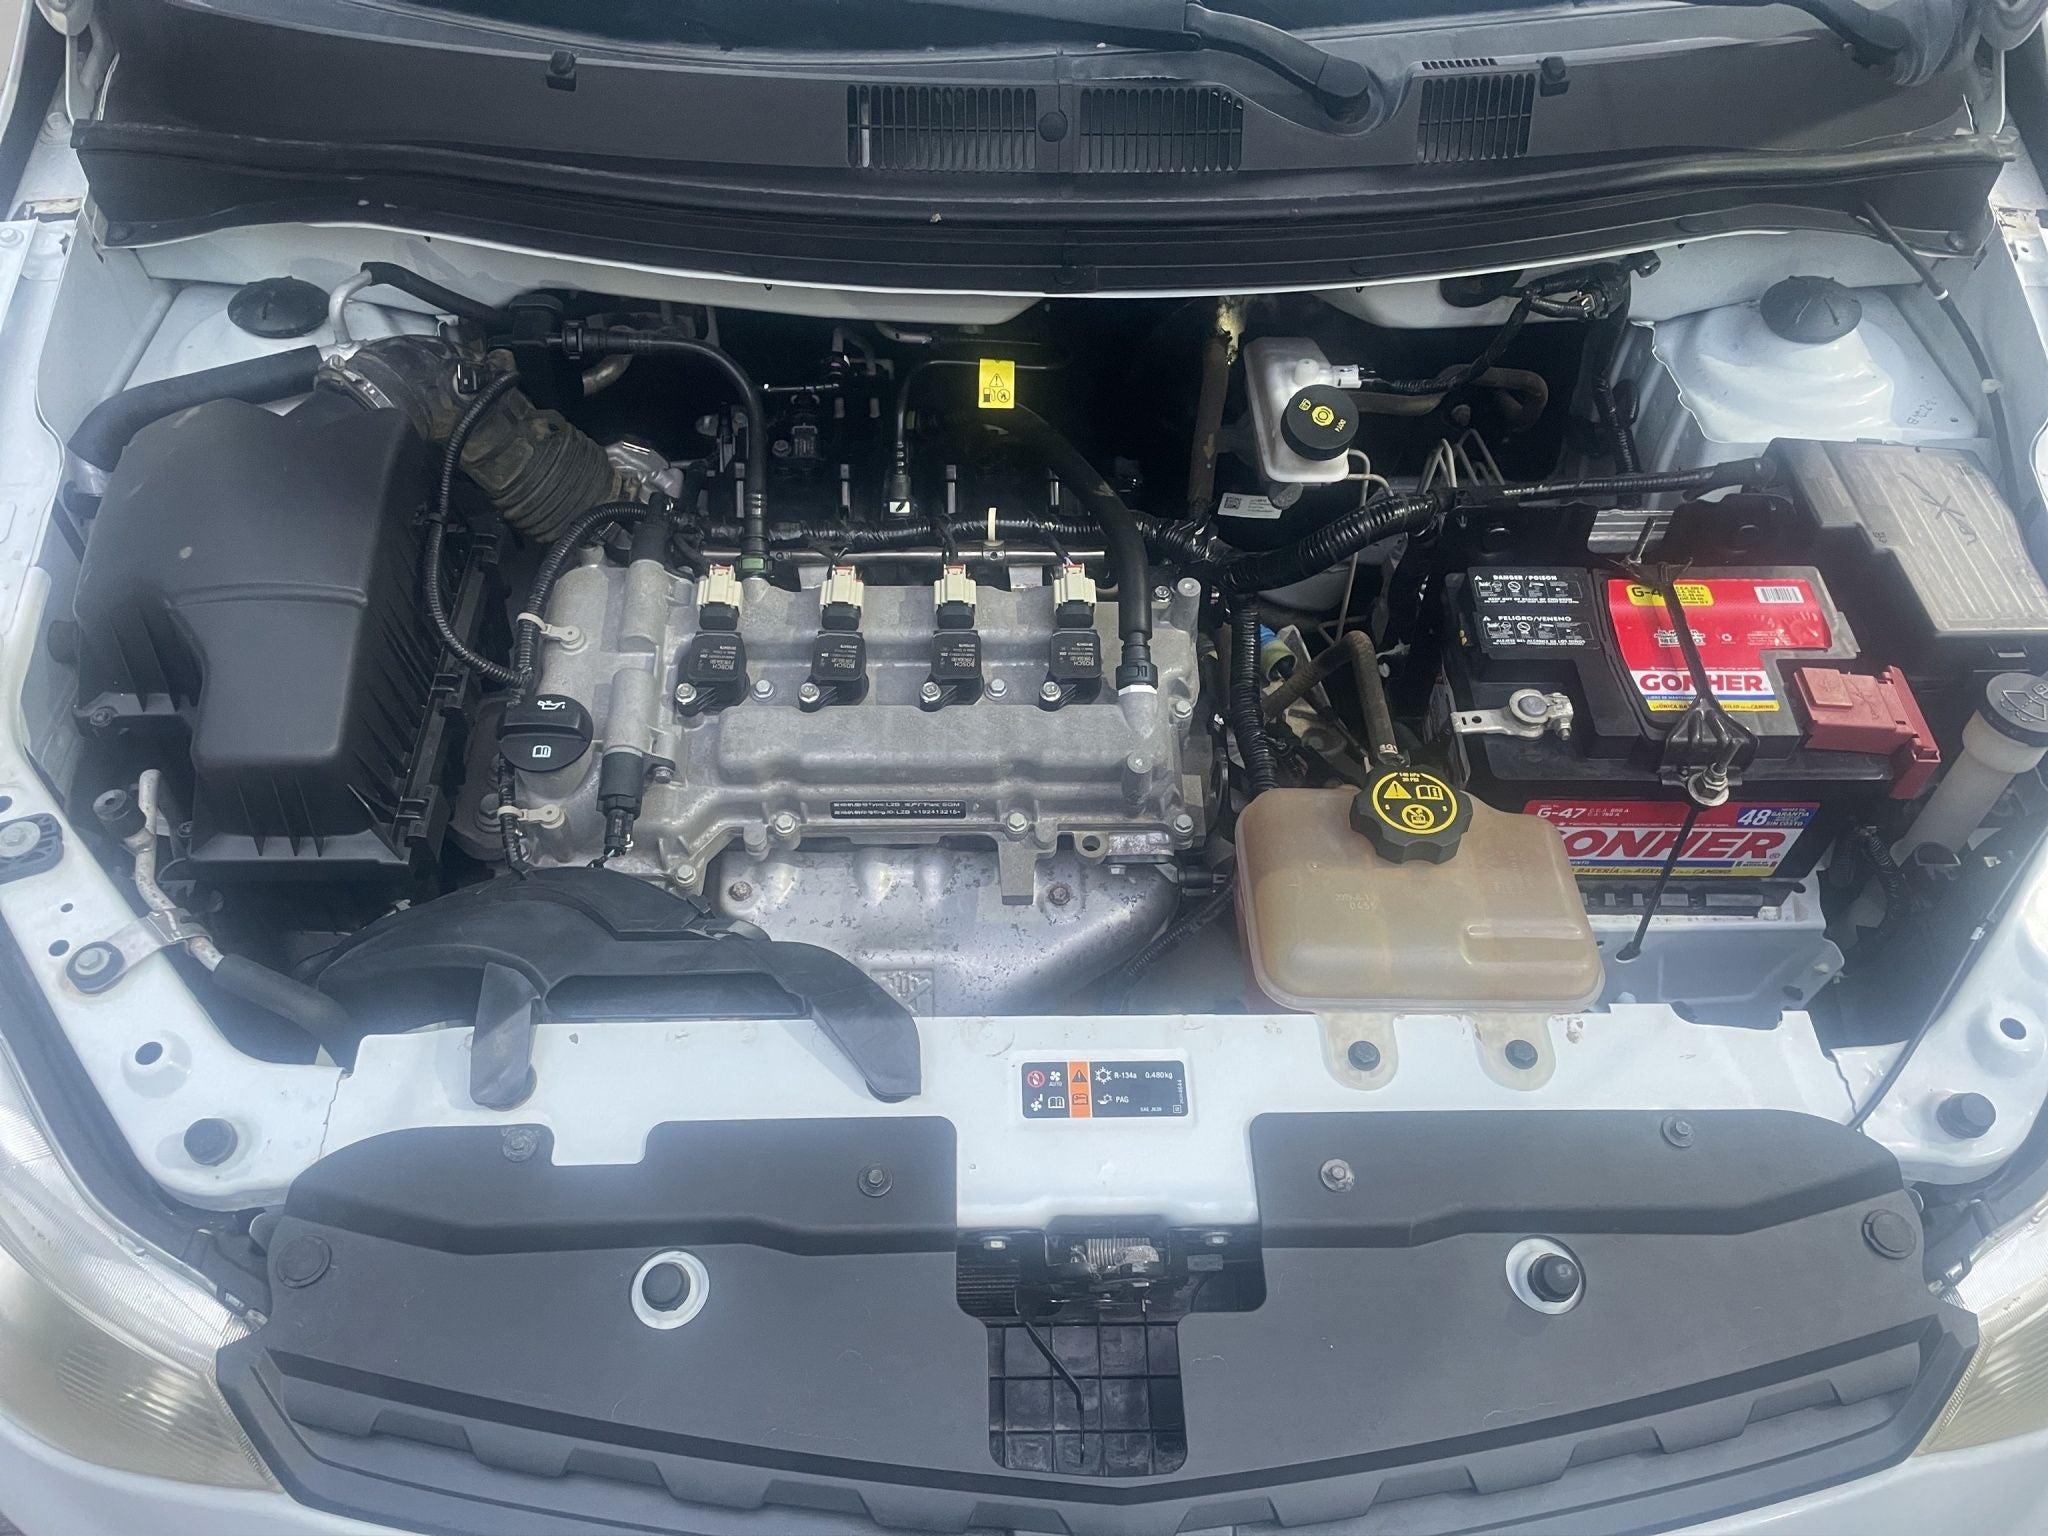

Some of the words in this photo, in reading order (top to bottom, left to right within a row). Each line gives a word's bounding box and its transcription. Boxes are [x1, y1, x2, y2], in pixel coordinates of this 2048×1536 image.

[1537, 807, 1586, 819] G-47
[1737, 809, 1772, 826] 48
[1561, 829, 1786, 858] ONHER
